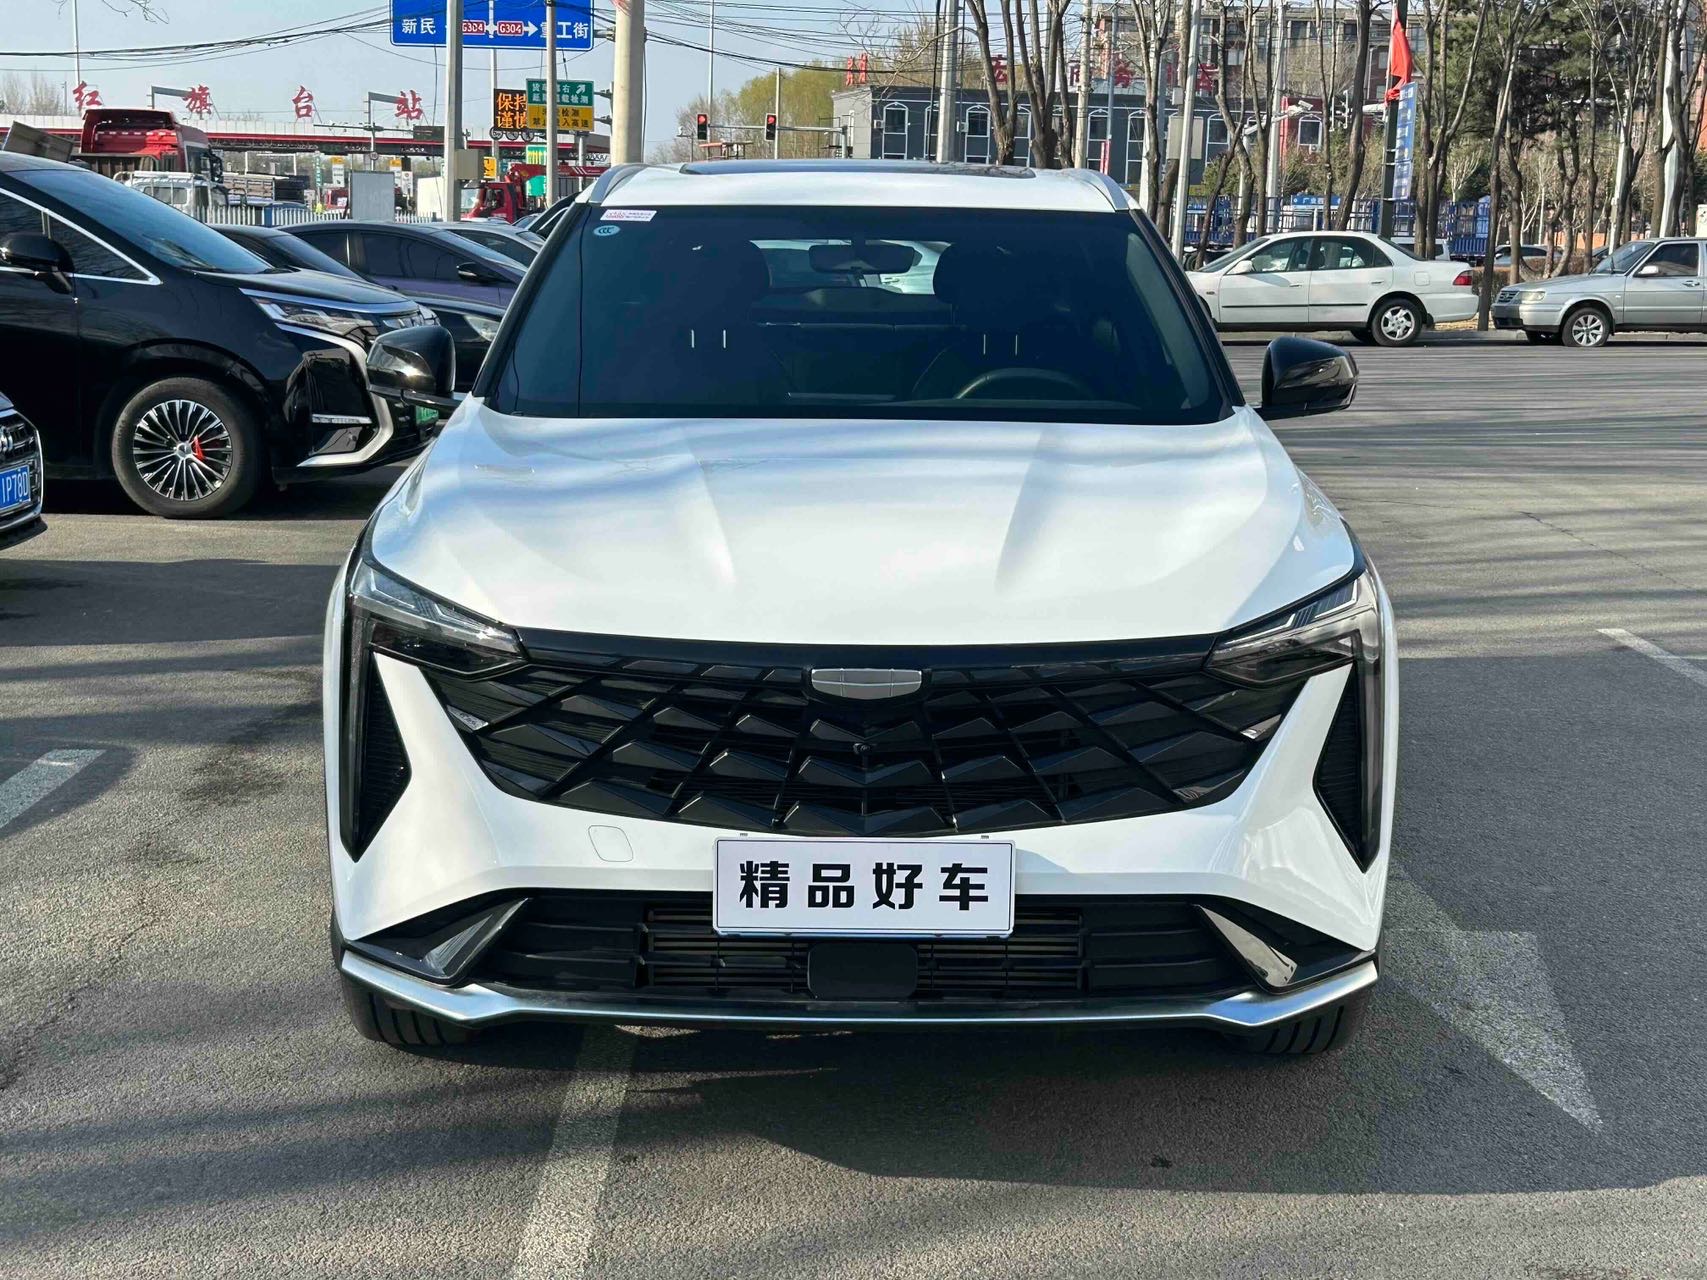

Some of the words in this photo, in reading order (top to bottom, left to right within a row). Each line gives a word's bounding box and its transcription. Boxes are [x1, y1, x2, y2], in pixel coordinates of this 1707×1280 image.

[401, 17, 436, 34] 新民
[499, 22, 522, 34] G304
[73, 81, 423, 121] 红旗台站
[739, 861, 989, 911] 精品好车
